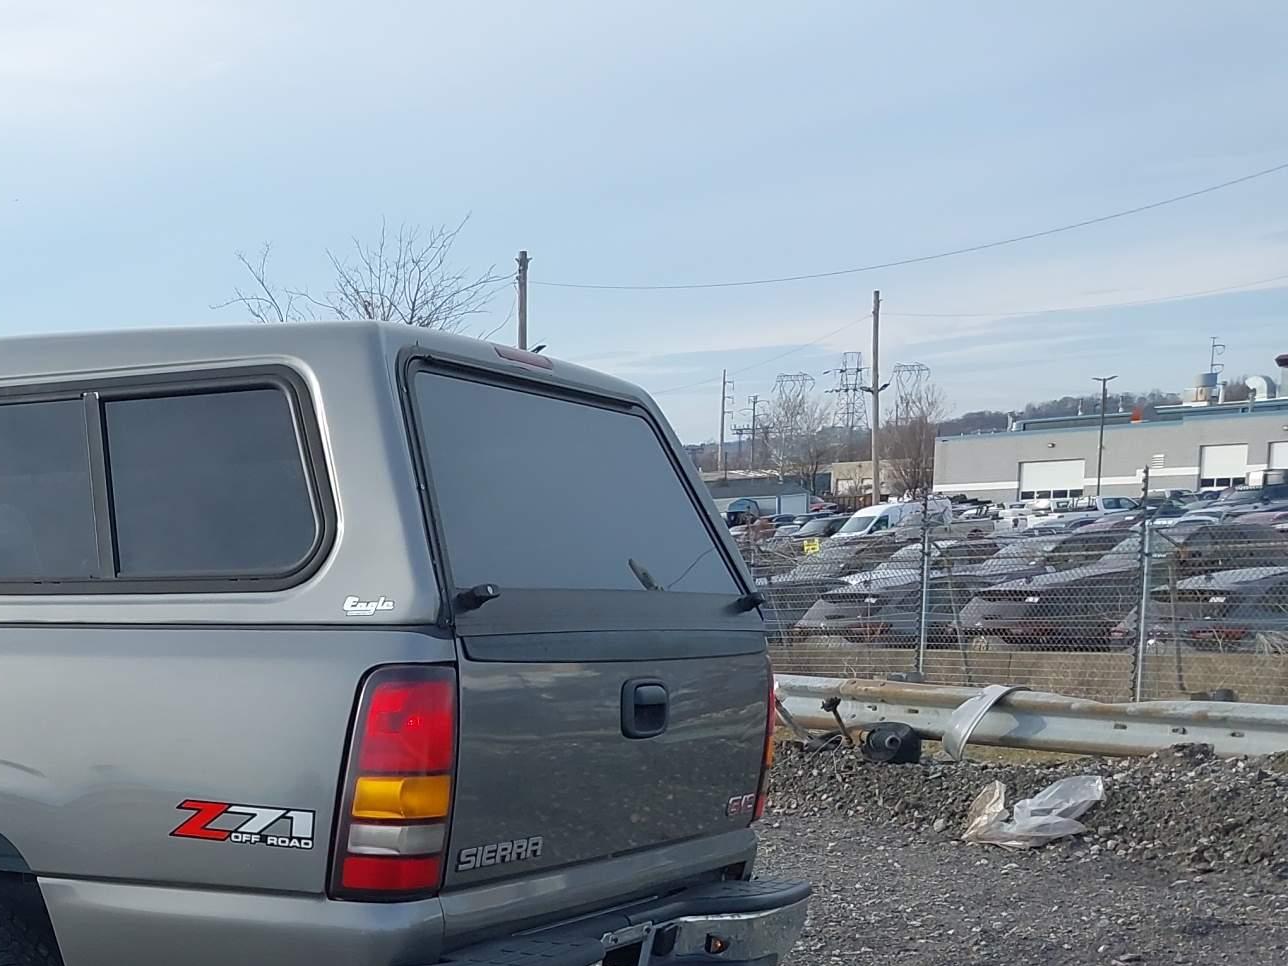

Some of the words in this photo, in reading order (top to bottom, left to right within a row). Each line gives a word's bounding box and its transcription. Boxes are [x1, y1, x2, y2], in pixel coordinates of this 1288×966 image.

[343, 596, 394, 616] Eagle
[170, 799, 315, 841] Z71
[230, 832, 261, 844] OFF
[266, 835, 313, 849] ROAD
[456, 836, 543, 871] SIERRA
